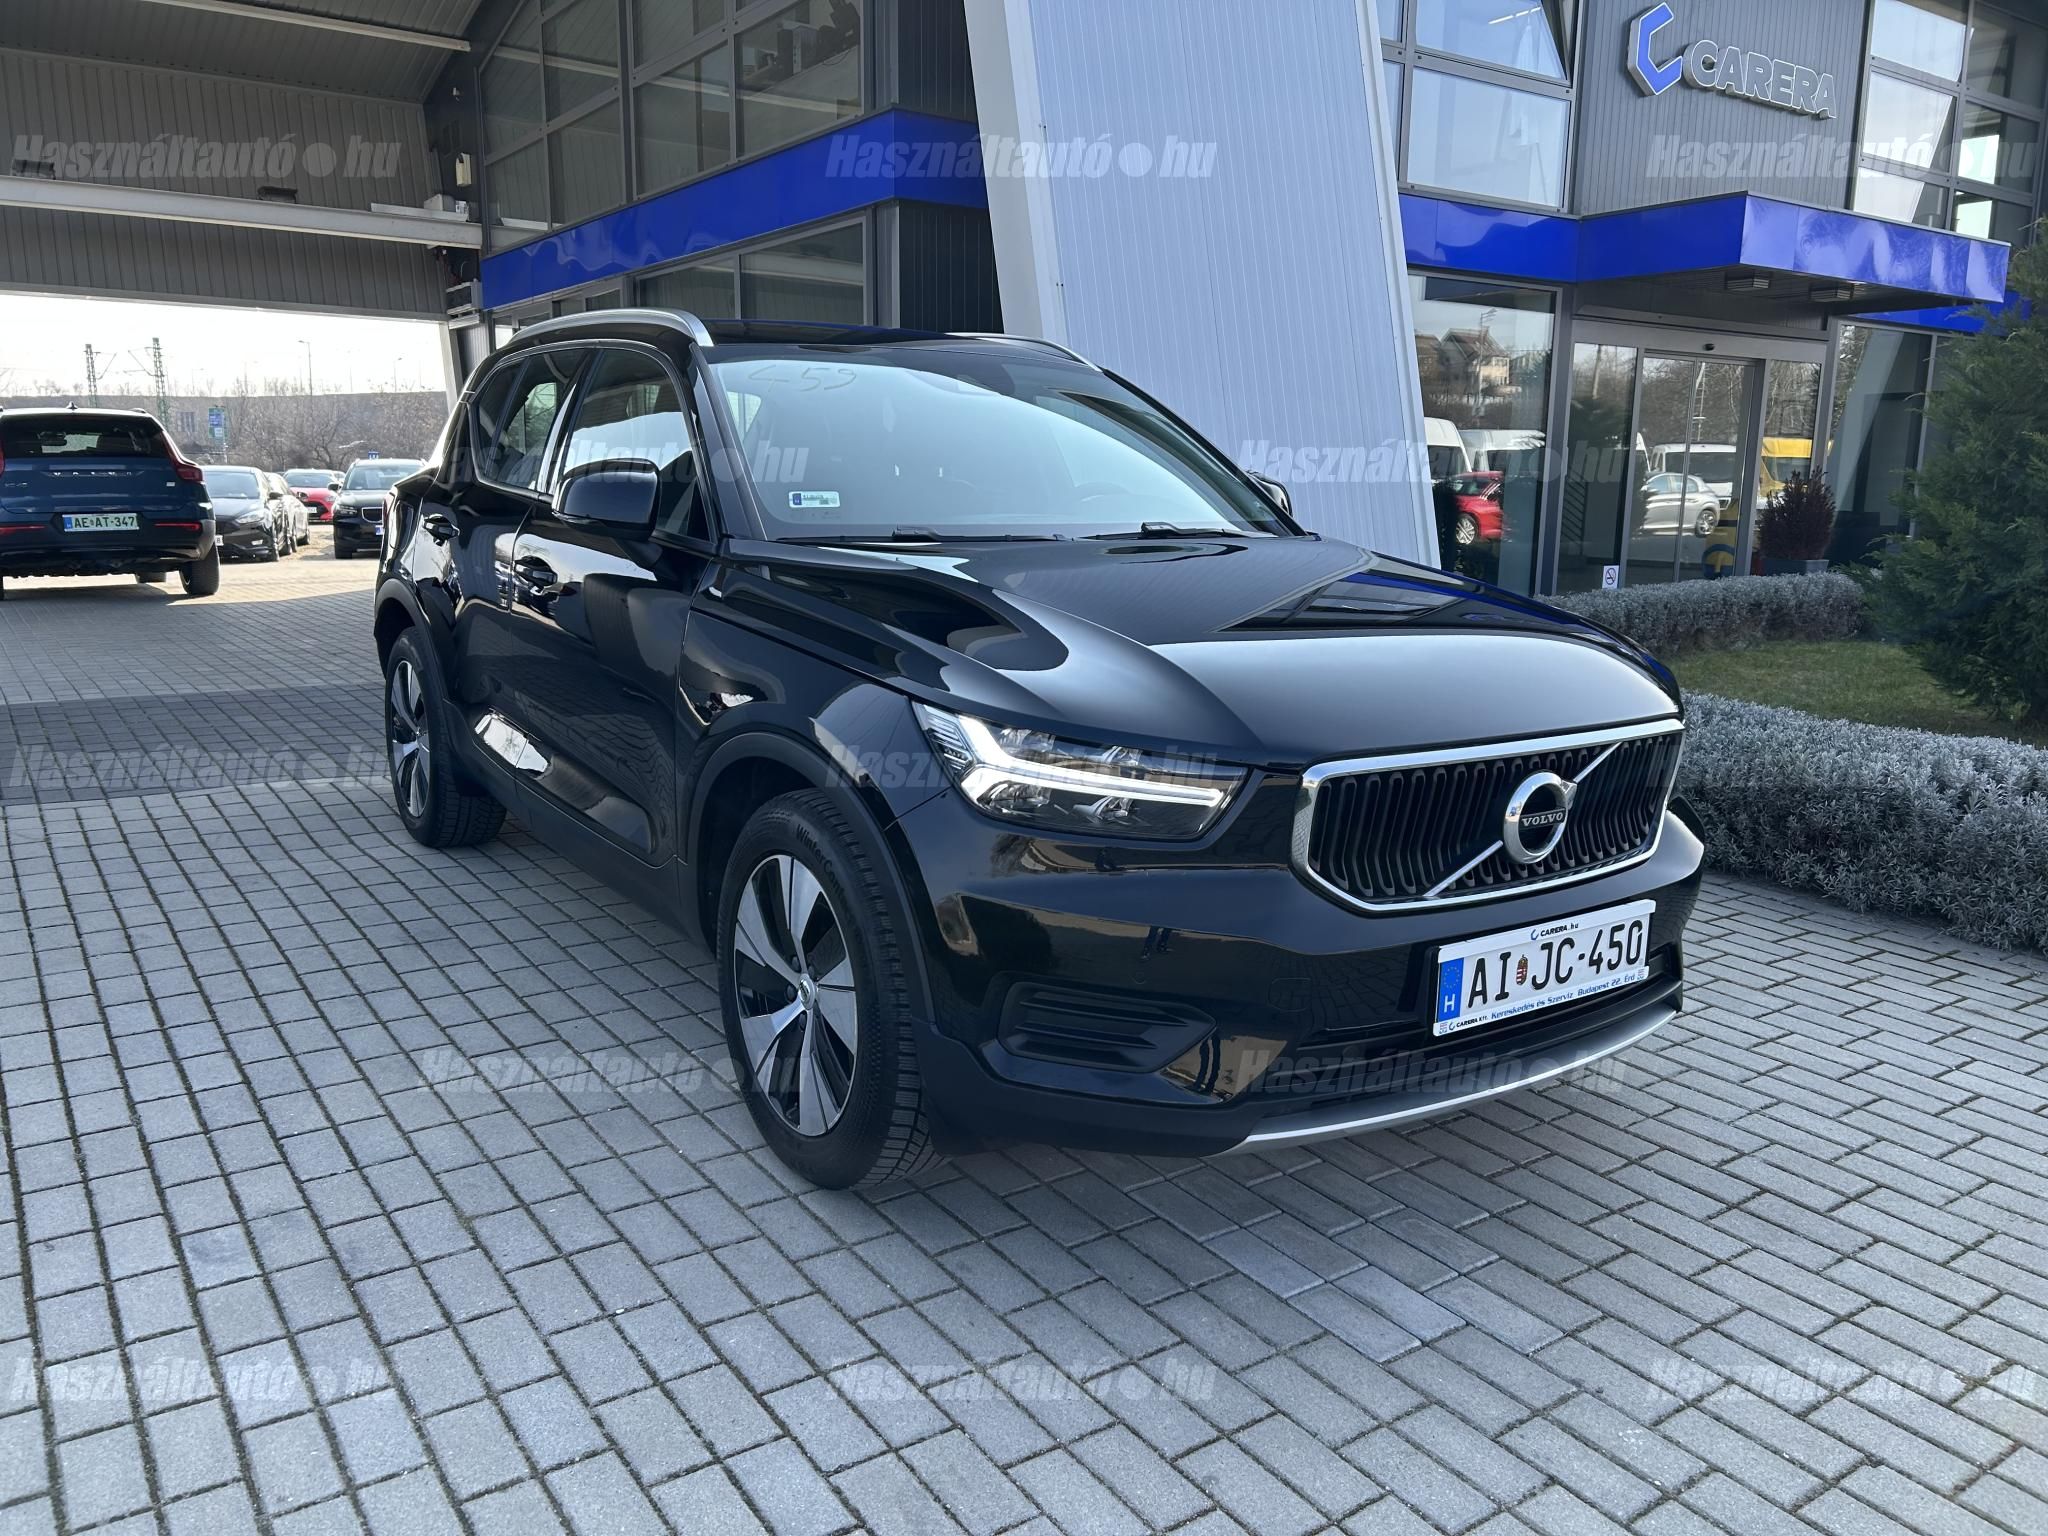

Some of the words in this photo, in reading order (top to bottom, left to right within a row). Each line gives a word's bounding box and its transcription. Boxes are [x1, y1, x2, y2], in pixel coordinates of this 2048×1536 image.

[1688, 39, 1837, 119] CARERA
[75, 517, 90, 528] AE
[96, 516, 135, 527] AT-347
[1521, 811, 1564, 827] VOLVO
[1468, 951, 1512, 1008] AI
[1531, 919, 1644, 990] JC-450
[1443, 993, 1456, 1013] H
[1491, 1003, 1535, 1019] Kereskedés
[1578, 982, 1609, 997] Budapest
